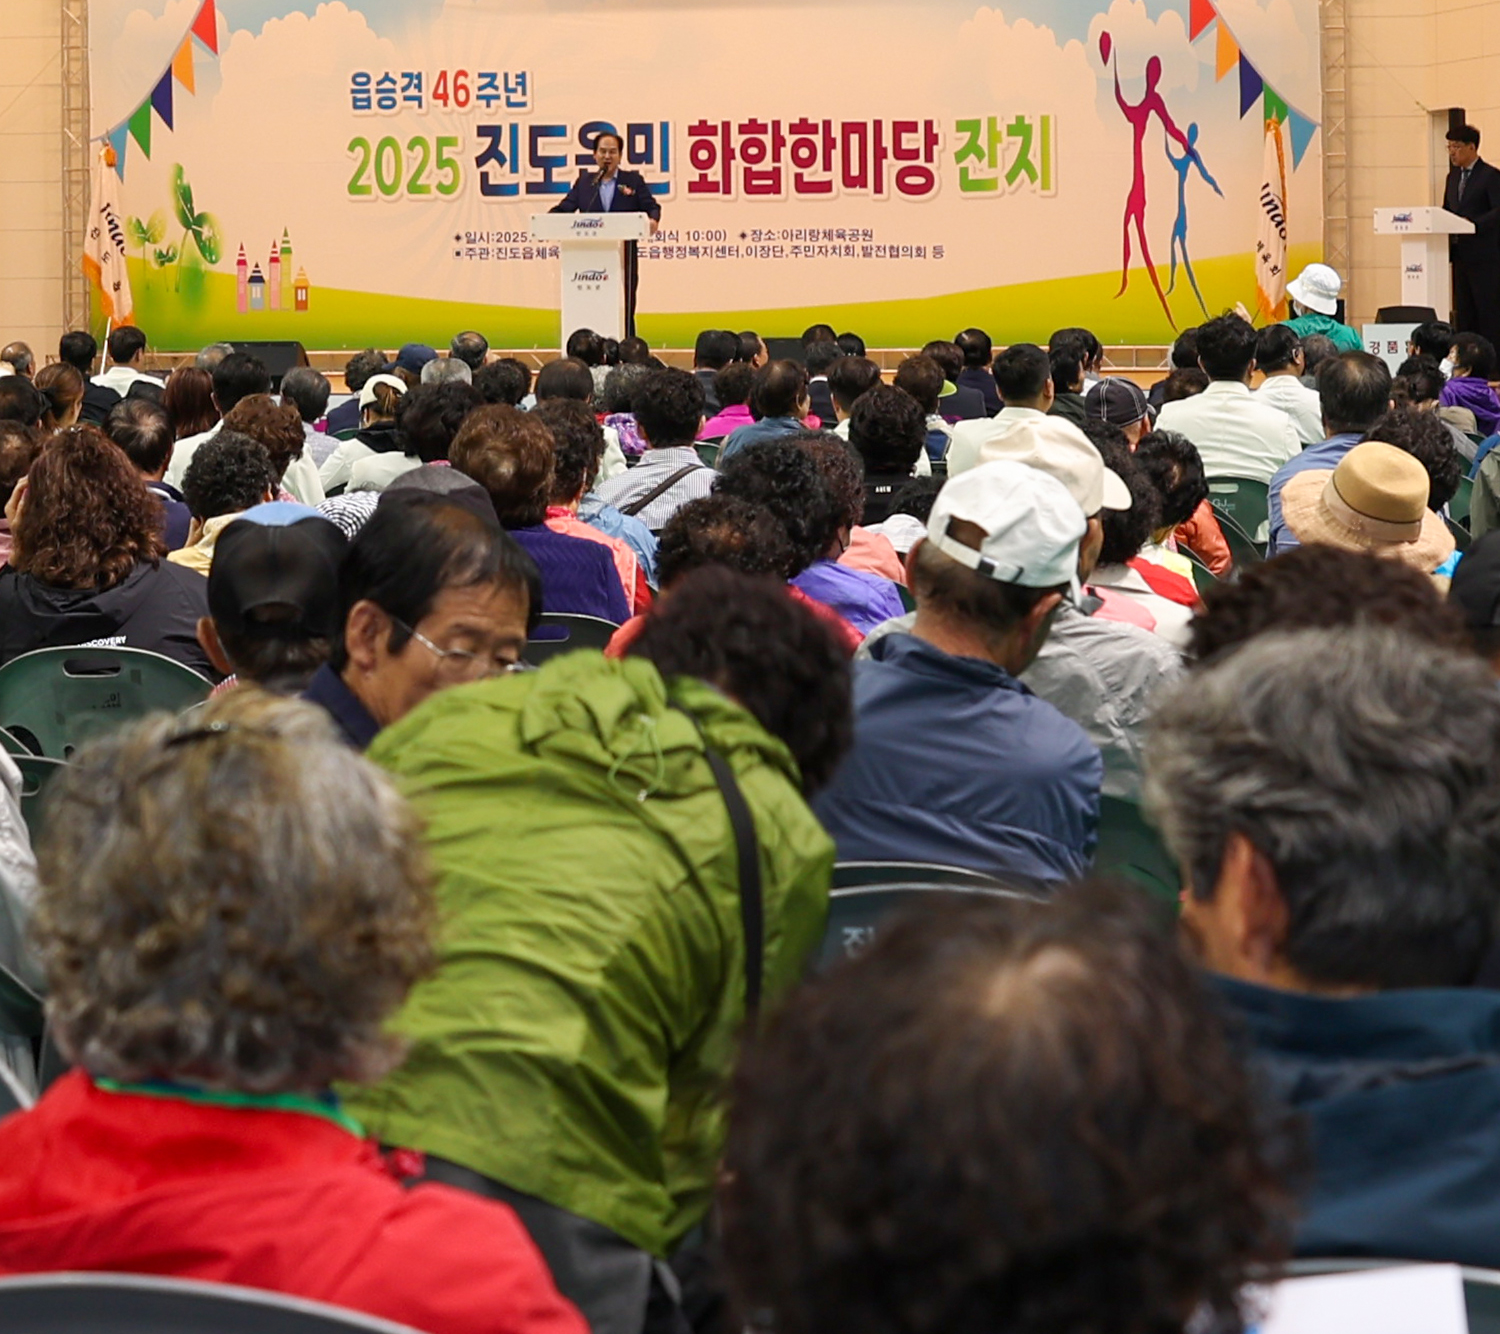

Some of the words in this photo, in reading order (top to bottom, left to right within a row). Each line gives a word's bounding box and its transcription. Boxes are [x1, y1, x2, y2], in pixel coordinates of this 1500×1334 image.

[350, 72, 423, 109] 읍승격
[347, 136, 461, 195] 2025
[687, 118, 939, 196] 화합한마당
[954, 115, 1051, 193] 잔치
[642, 230, 679, 244] 회식
[685, 229, 727, 243] 10:00)
[932, 245, 945, 259] 등
[571, 272, 602, 282] Jindo
[1369, 341, 1408, 355] 경품
